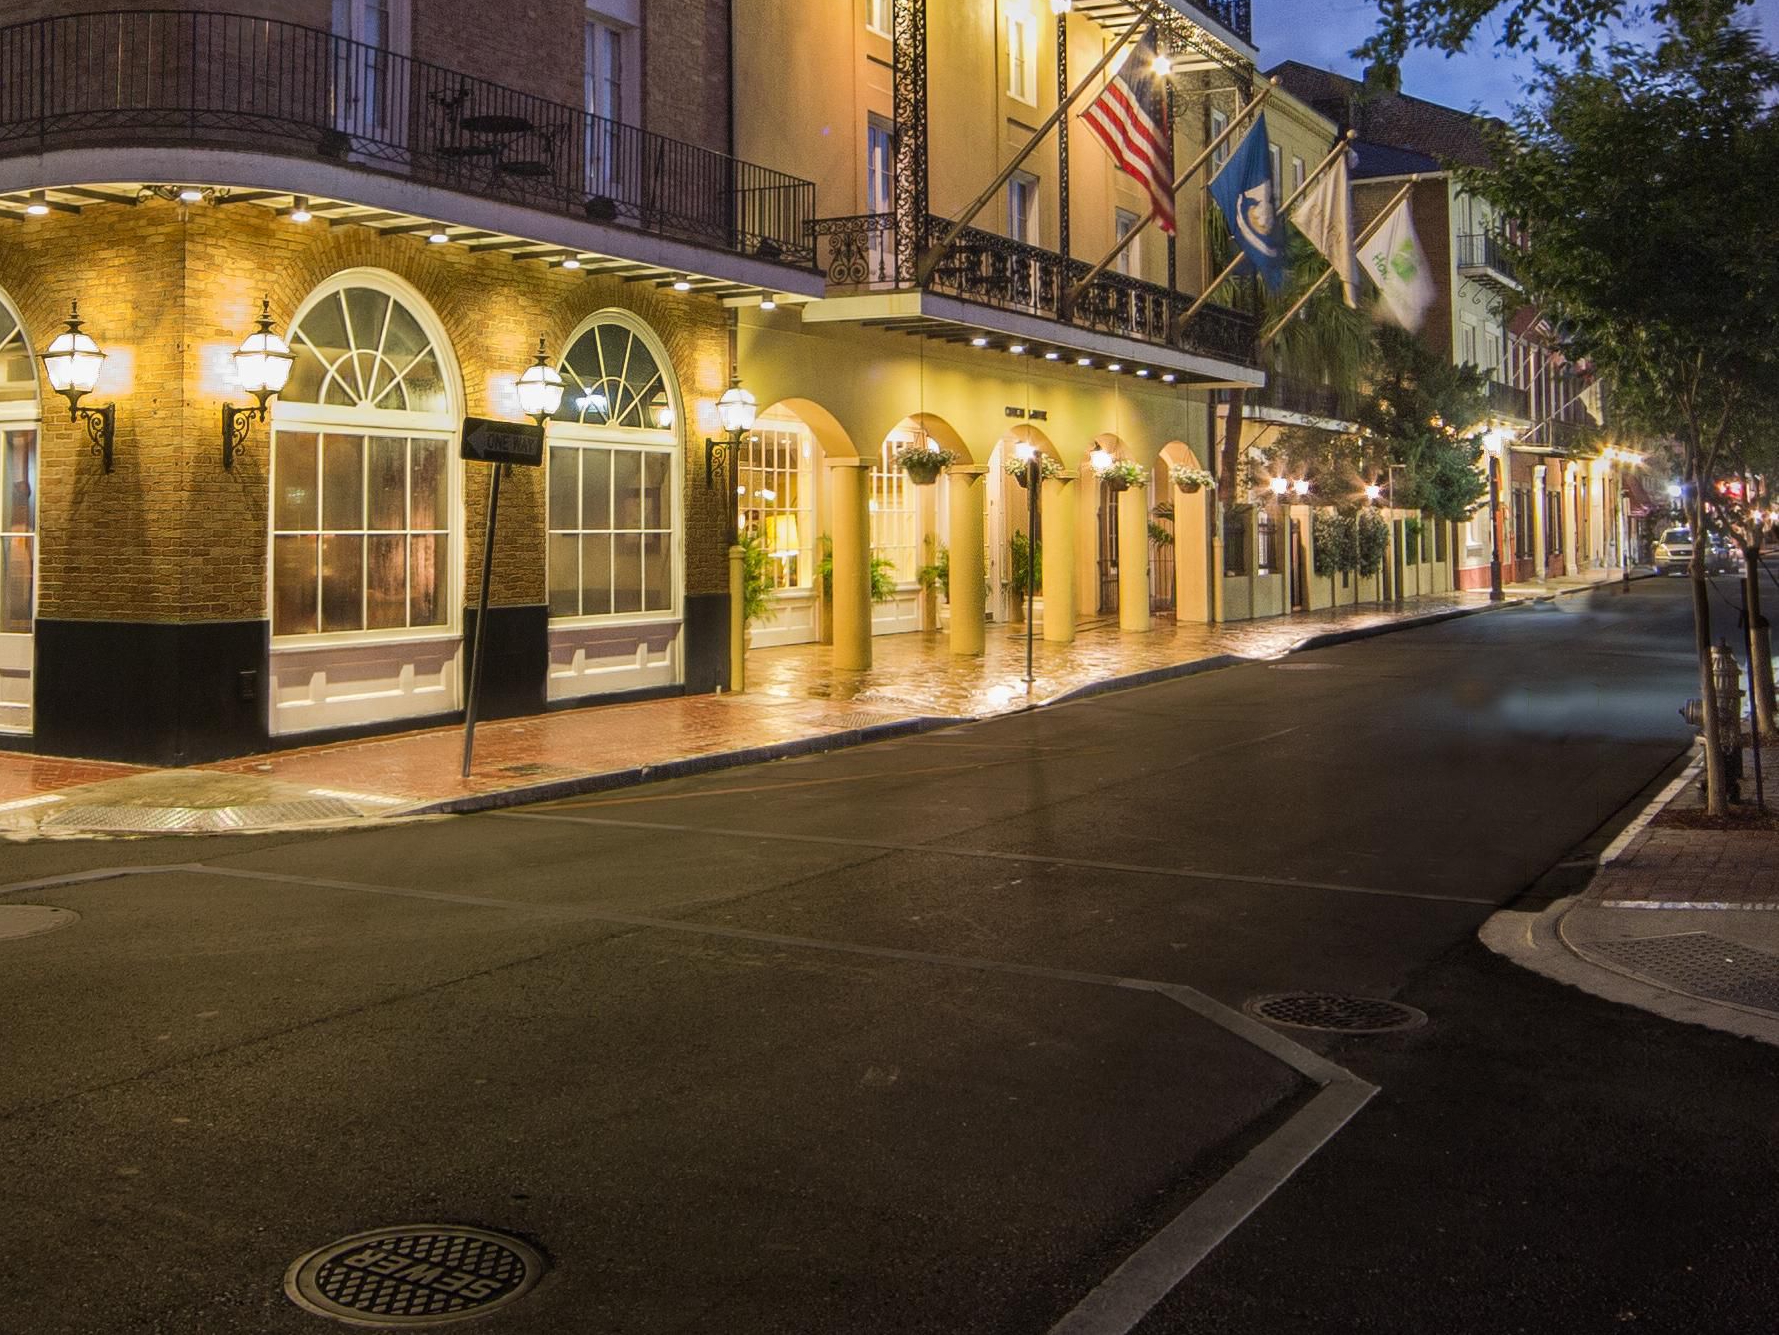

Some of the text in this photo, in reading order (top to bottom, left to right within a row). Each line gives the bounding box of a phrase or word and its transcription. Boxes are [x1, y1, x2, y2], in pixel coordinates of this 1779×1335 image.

[486, 433, 537, 455] ONE WAY
[344, 1249, 502, 1299] SEWER
